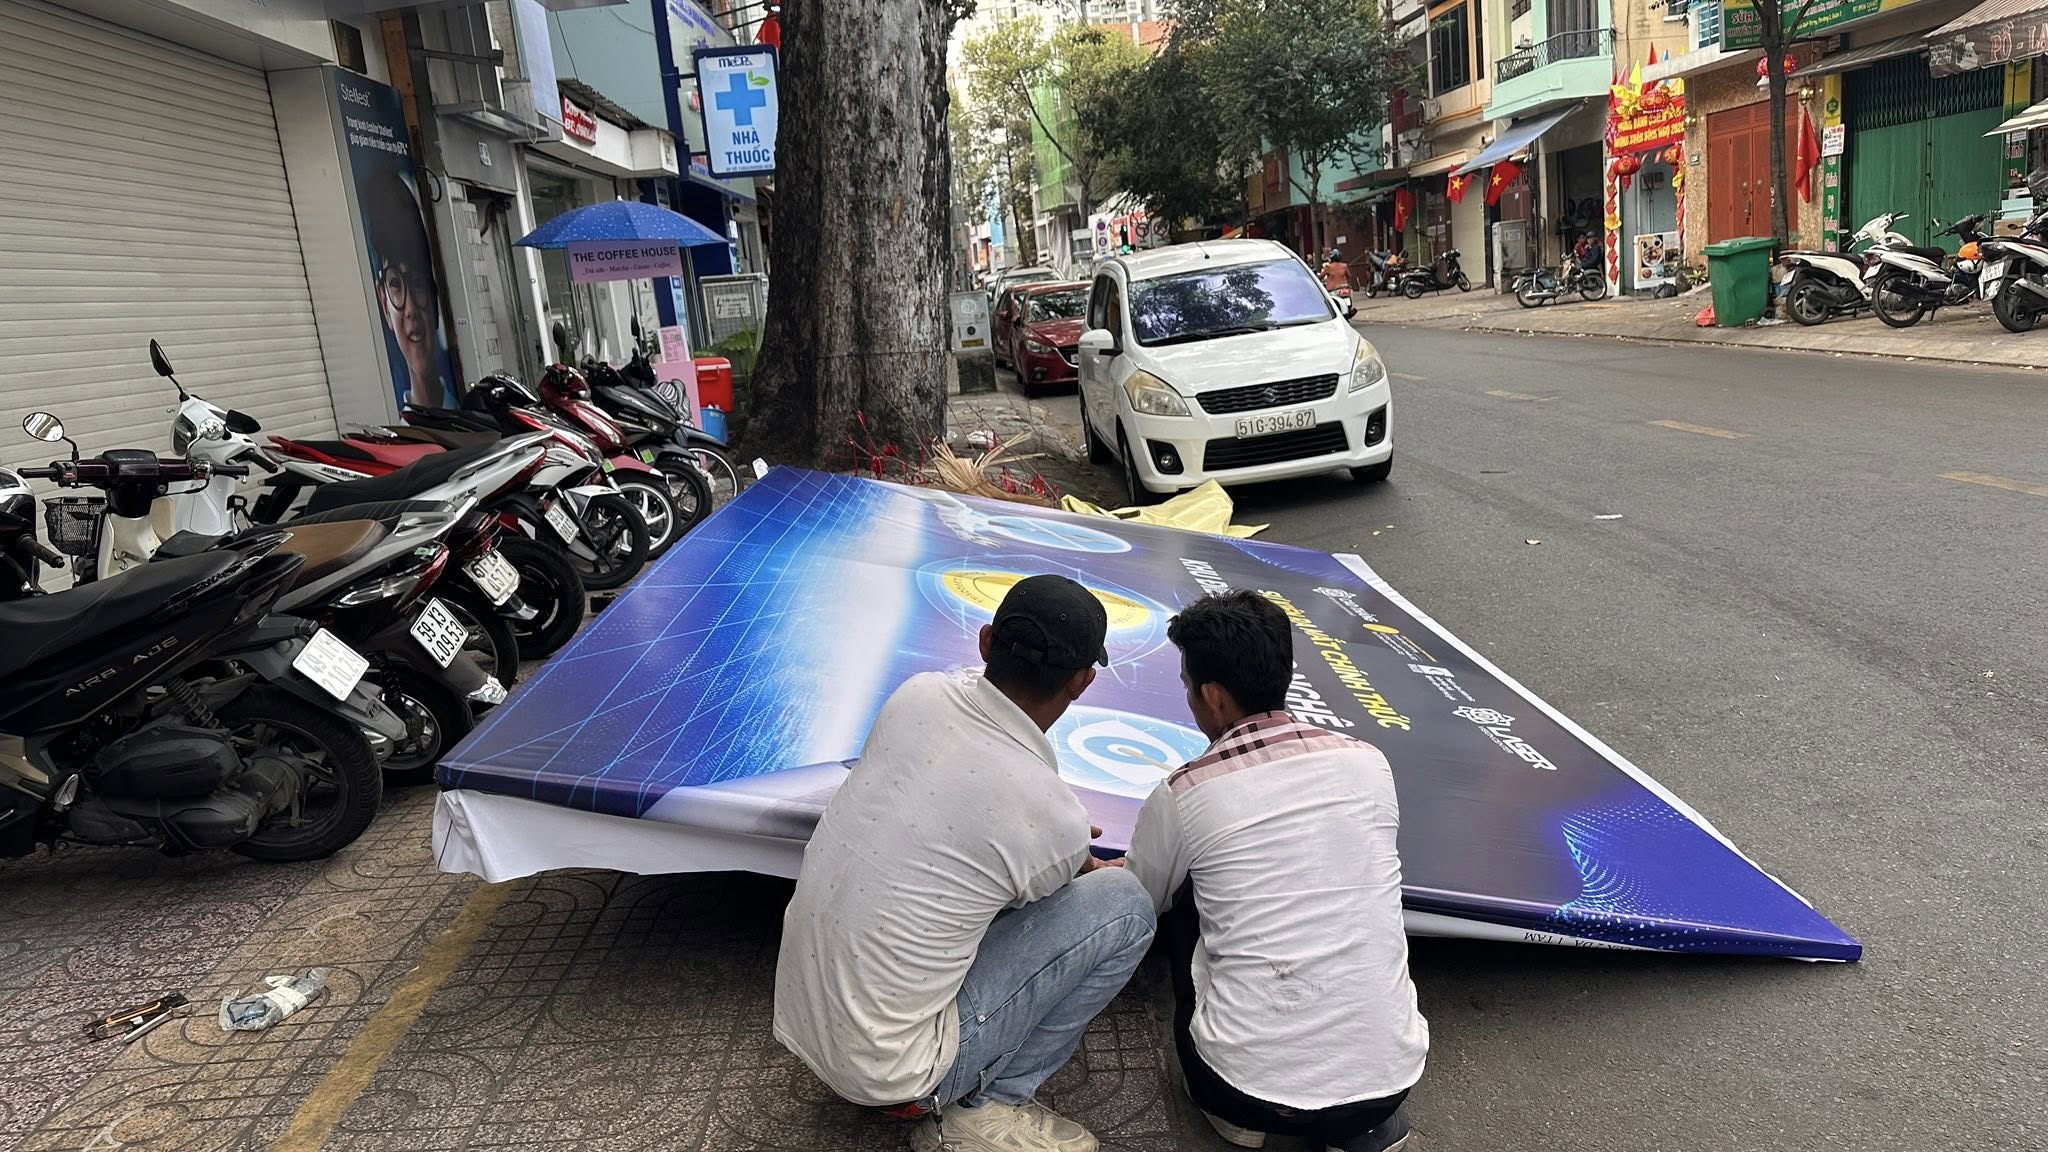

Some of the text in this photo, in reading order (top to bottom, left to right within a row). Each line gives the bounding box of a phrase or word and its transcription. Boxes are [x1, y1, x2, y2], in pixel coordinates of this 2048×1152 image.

[732, 127, 760, 145] NHÀ
[725, 144, 771, 165] THUỐC
[573, 246, 677, 262] THE COFFEE HOUSE
[1239, 411, 1312, 436] 51G-394.87
[416, 606, 447, 643] 59-X3
[431, 620, 464, 662] 409.53
[1320, 650, 1375, 692] CHÍNH
[1353, 692, 1411, 731] THỨC
[1486, 726, 1558, 771] LASER
